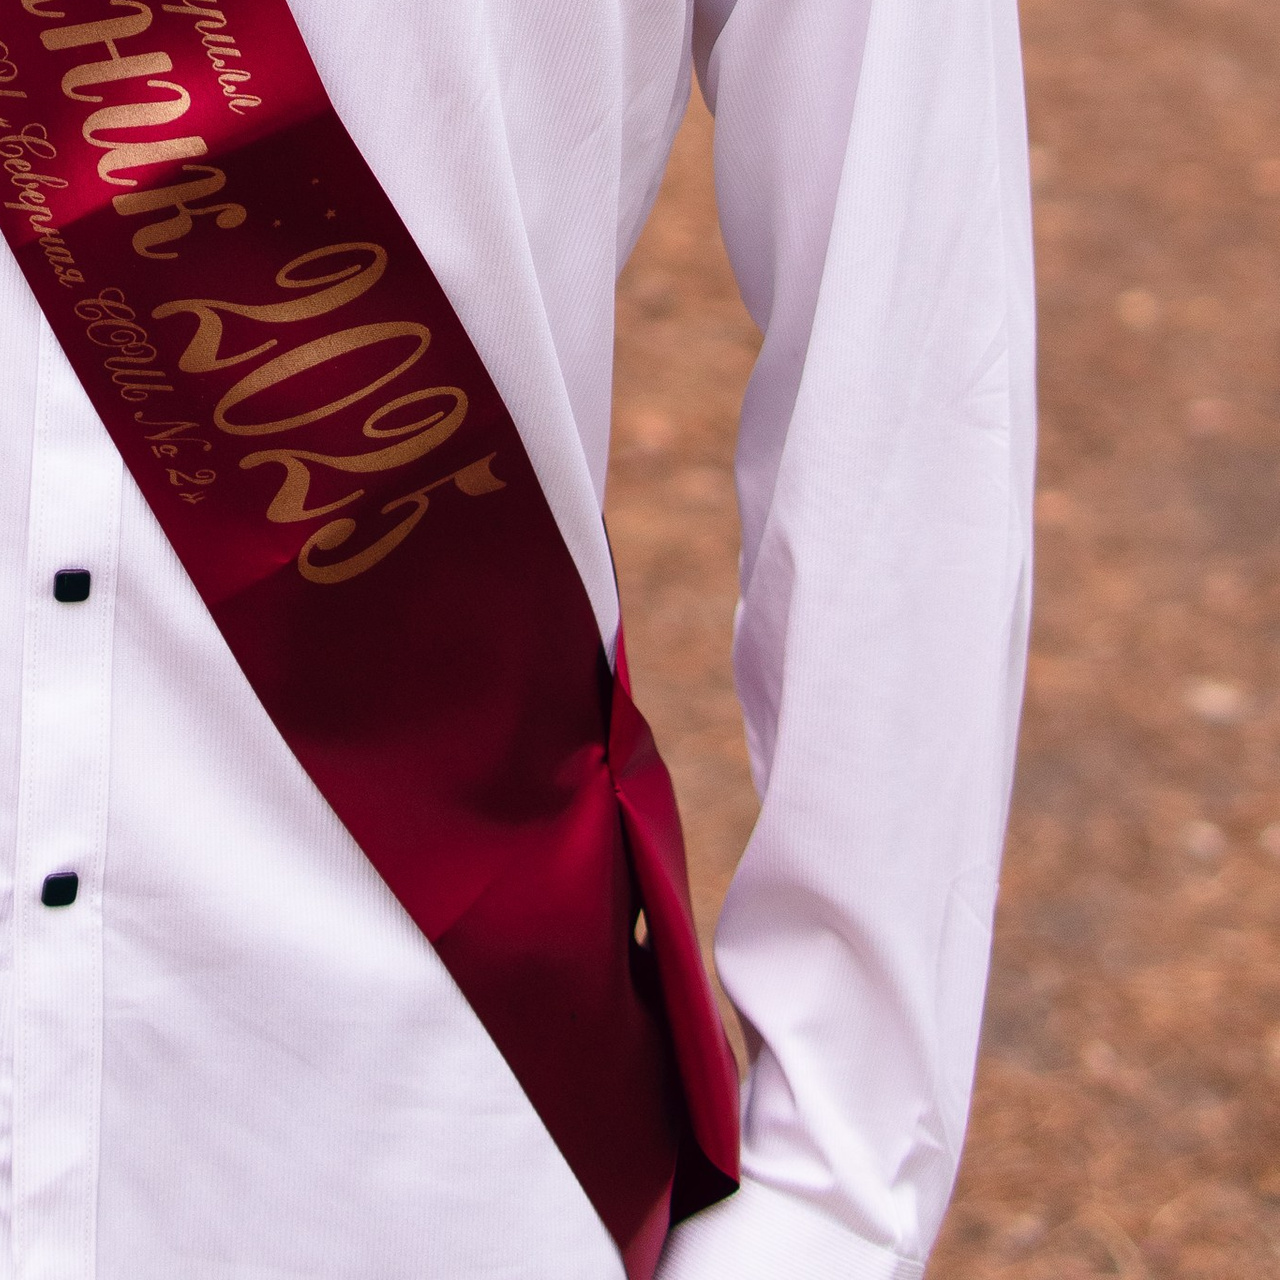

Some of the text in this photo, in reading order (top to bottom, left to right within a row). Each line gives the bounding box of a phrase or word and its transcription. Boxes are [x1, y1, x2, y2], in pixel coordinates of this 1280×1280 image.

[74, 287, 174, 402] СОШ
[134, 411, 212, 458] №
[152, 242, 507, 584] 2025
[165, 468, 216, 505] 2»
